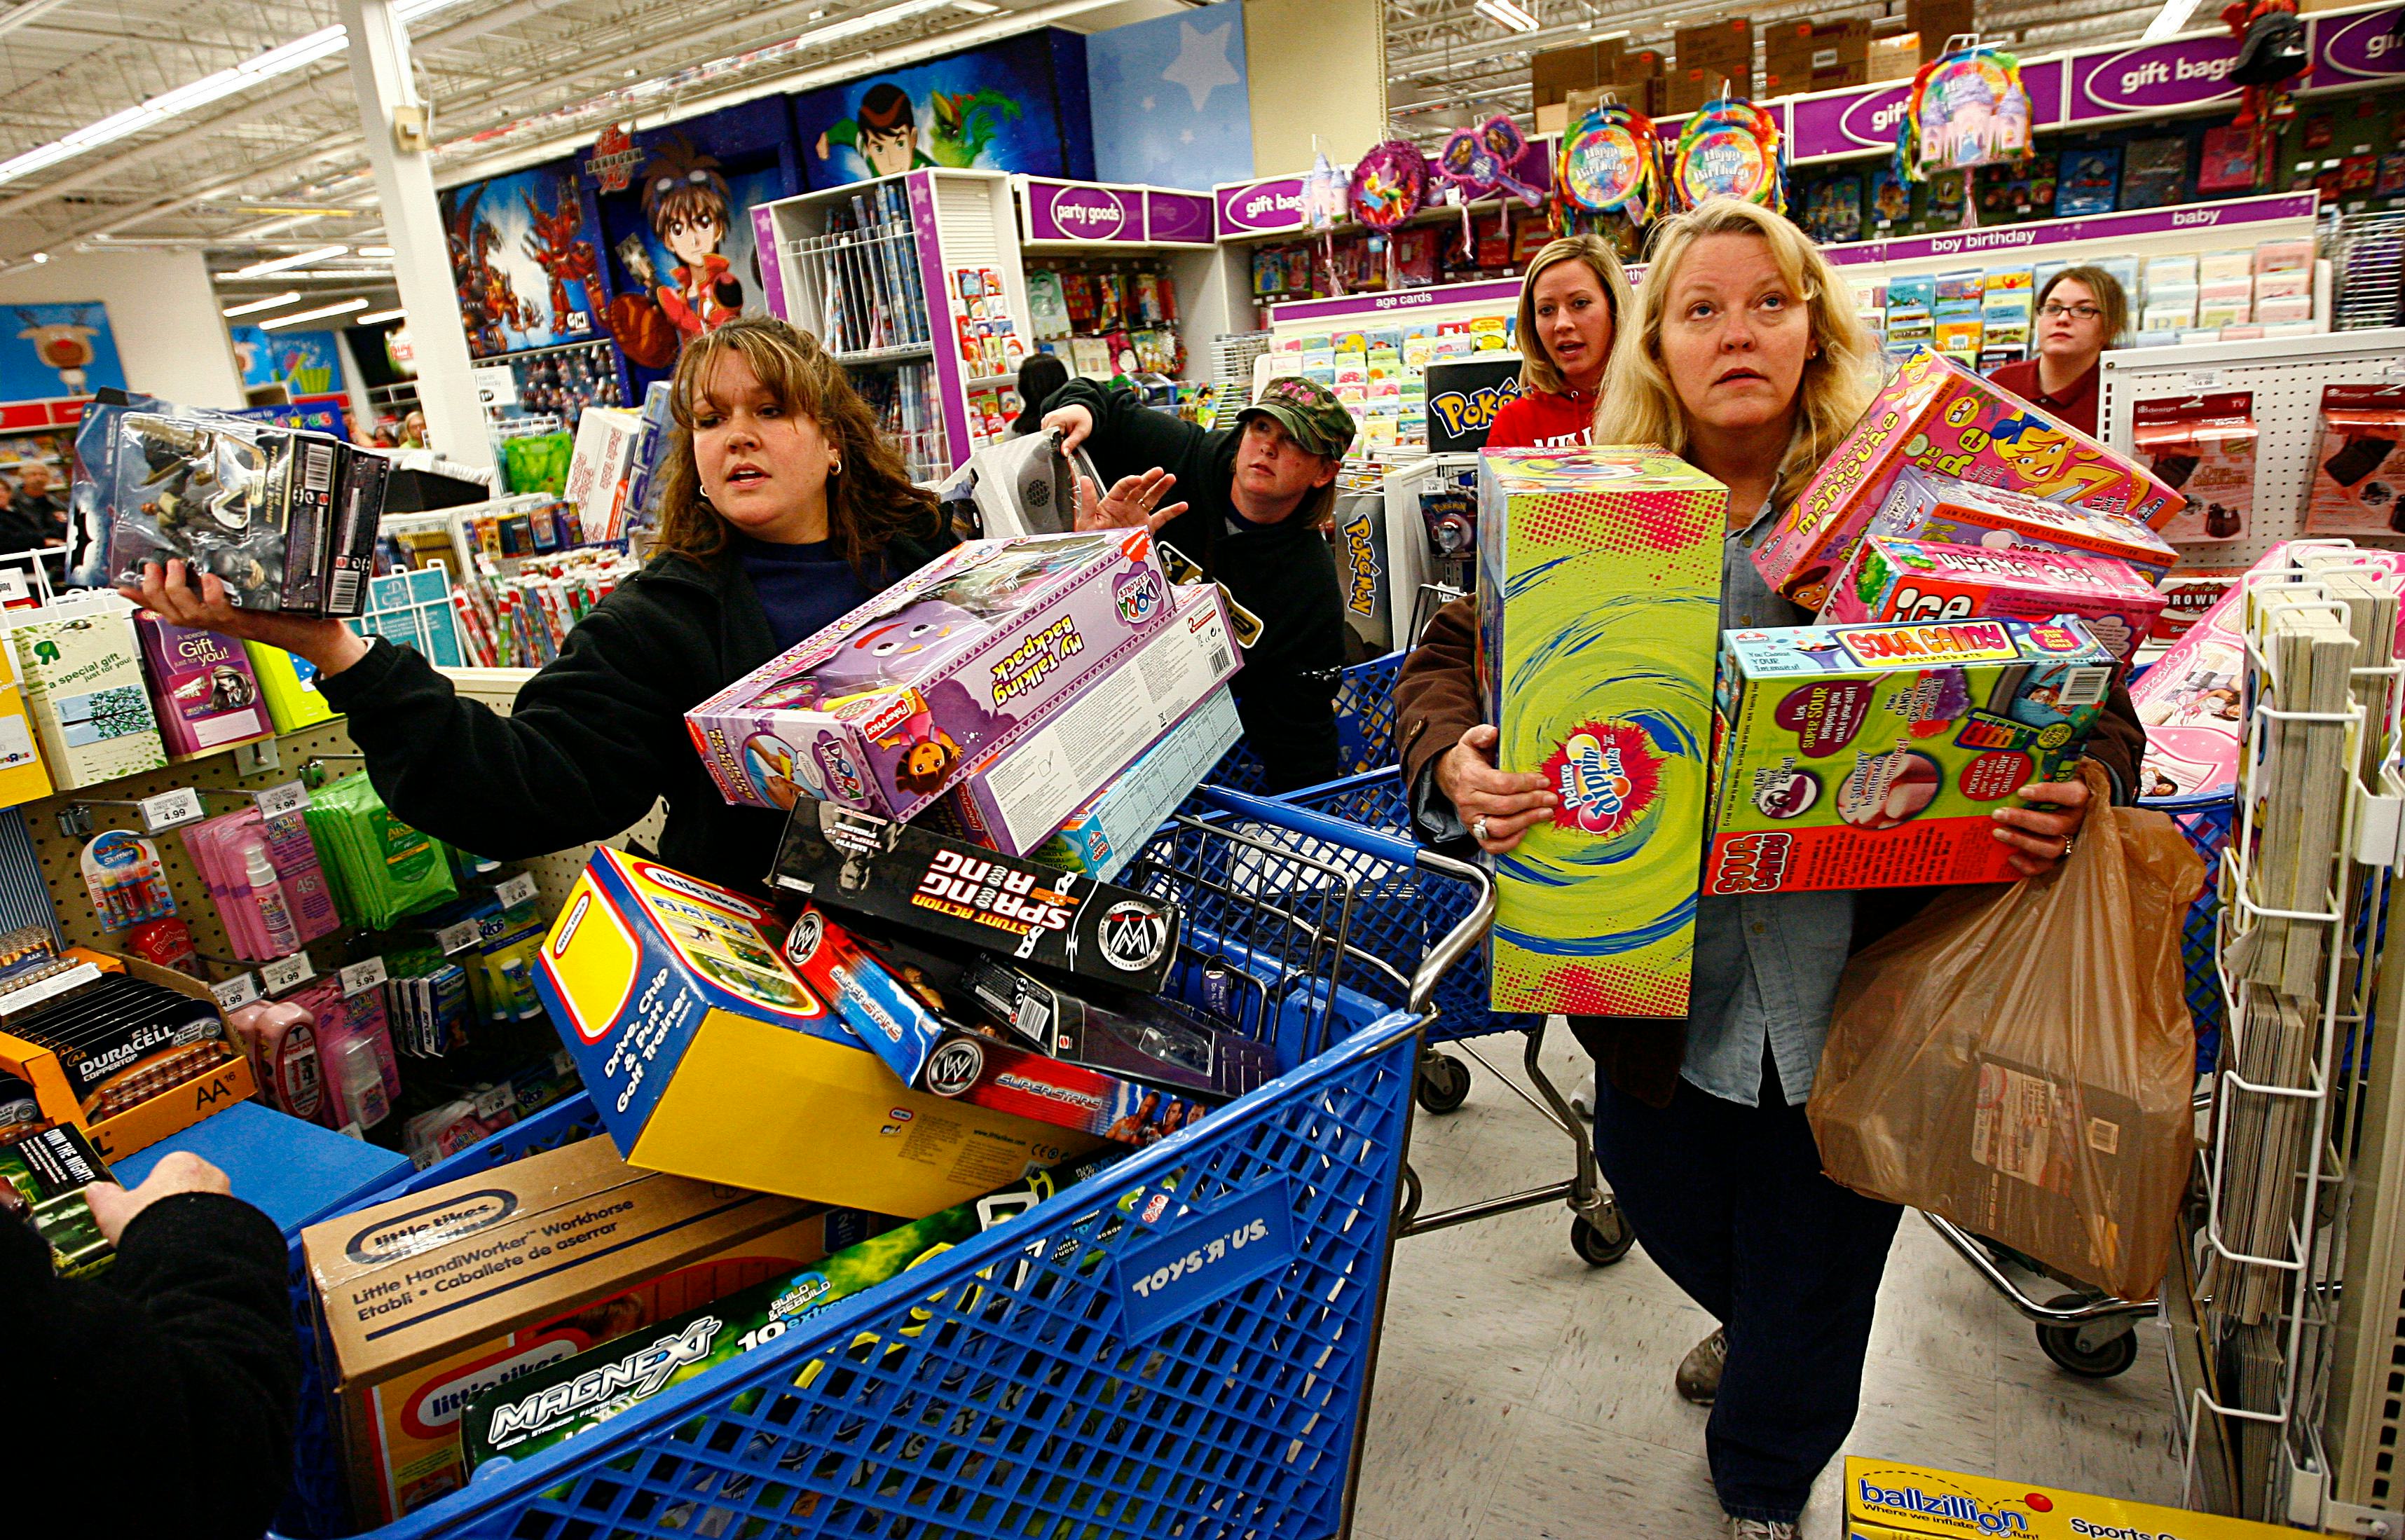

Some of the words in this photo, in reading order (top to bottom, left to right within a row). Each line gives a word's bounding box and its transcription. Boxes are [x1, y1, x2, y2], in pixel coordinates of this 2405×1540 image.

[2121, 61, 2170, 94] gift
[1584, 146, 1619, 160] Happy
[1704, 149, 1741, 162] Happy
[1576, 162, 1627, 180] Birthday
[1693, 167, 1750, 183] Birthday
[1057, 205, 1086, 224] party
[1089, 203, 1119, 224] goods
[1246, 195, 1273, 218] gift
[1276, 193, 1302, 213] bag
[2172, 209, 2220, 226] baby
[1931, 238, 1961, 253] boy
[1966, 230, 2036, 249] birthday
[1376, 295, 1397, 308] age
[1400, 291, 1432, 305] cards
[1116, 579, 1161, 621] DORA
[178, 638, 217, 659] Gift
[198, 647, 230, 668] you!
[991, 614, 1075, 682] Backpack
[1060, 632, 1085, 661] My
[1847, 631, 1928, 659] SOUR
[1918, 624, 2006, 654] CANDY
[48, 680, 57, 690] a
[57, 661, 100, 687] special
[100, 652, 121, 671] gift
[83, 671, 100, 684] just
[101, 664, 115, 675] for
[115, 656, 133, 672] you!
[992, 652, 1060, 708] Talking
[1792, 704, 1808, 721] Lick
[1819, 706, 1837, 740] lollipops
[1830, 692, 1842, 706] you
[1840, 687, 1858, 722] yourself!
[1896, 687, 1914, 717] CANDY
[1907, 677, 1933, 724] CRYSTALS
[867, 701, 910, 736] Fisher-Price
[1802, 721, 1819, 749] SUPER
[1812, 687, 1830, 719] SOUR
[1835, 721, 1846, 743] make
[828, 740, 864, 800] DORA
[1604, 747, 1625, 777] dots
[1755, 767, 1767, 788] TART
[1780, 757, 1797, 785] candy!
[1850, 750, 1870, 798] SQUISHY
[1879, 738, 1912, 802] marshmallows!
[1967, 768, 1983, 795] PUCKER
[1979, 759, 1987, 769] UP
[1987, 781, 1999, 797] with
[1996, 755, 2011, 776] SOUR
[2000, 757, 2022, 794] CHALLENGE!
[1558, 764, 1582, 811] Deluxe
[1581, 747, 1623, 818] dippin'
[1765, 768, 1779, 790] liquid
[1861, 755, 1886, 809] homemade
[163, 808, 186, 822] 4.99
[275, 799, 296, 812] 5.99
[840, 831, 882, 849] TRIPLE
[104, 848, 134, 865] Skittles
[1715, 834, 1764, 893] SOUR
[1753, 834, 1789, 892] CANDY
[656, 872, 704, 896] little
[705, 891, 752, 914] tikes
[911, 893, 975, 921] ACTION
[974, 911, 1032, 937] STUNT
[280, 972, 300, 986] 4.99
[356, 975, 376, 988] 5.99
[829, 963, 903, 1043] SUPERSTARS
[604, 1020, 642, 1079] Drive,
[638, 967, 670, 1015] Chip
[623, 1052, 638, 1073] &
[635, 1000, 666, 1050] Putt
[72, 1050, 88, 1063] AA
[79, 1025, 175, 1076] DURACELL
[616, 1061, 645, 1114] Golf
[642, 986, 689, 1062] Trainer
[82, 1052, 139, 1082] COPPERTOP
[196, 1078, 233, 1111] AA
[223, 1071, 237, 1083] 16
[994, 1072, 1104, 1111] SUPERSTARS
[43, 1128, 68, 1146] OWN
[55, 1141, 78, 1160] THE
[64, 1155, 95, 1183] NIGHT!
[374, 1222, 431, 1248] little
[351, 1279, 402, 1307] Little
[541, 1198, 634, 1238] Workhorse
[357, 1291, 414, 1323] Etabli
[434, 1255, 524, 1293] Caballete
[528, 1244, 552, 1260] de
[556, 1219, 619, 1251] aserrar
[1132, 1250, 1203, 1298] TOYS
[770, 1283, 810, 1310] BUILD
[737, 1321, 787, 1352] 10
[530, 1414, 575, 1438] STRONGER
[579, 1400, 611, 1418] FASTER
[1858, 1478, 2029, 1533] ballzillion
[1863, 1502, 1907, 1518] Where
[1909, 1513, 1931, 1524] we
[1932, 1515, 1975, 1531] inflate
[2010, 1529, 2041, 1540] fun!
